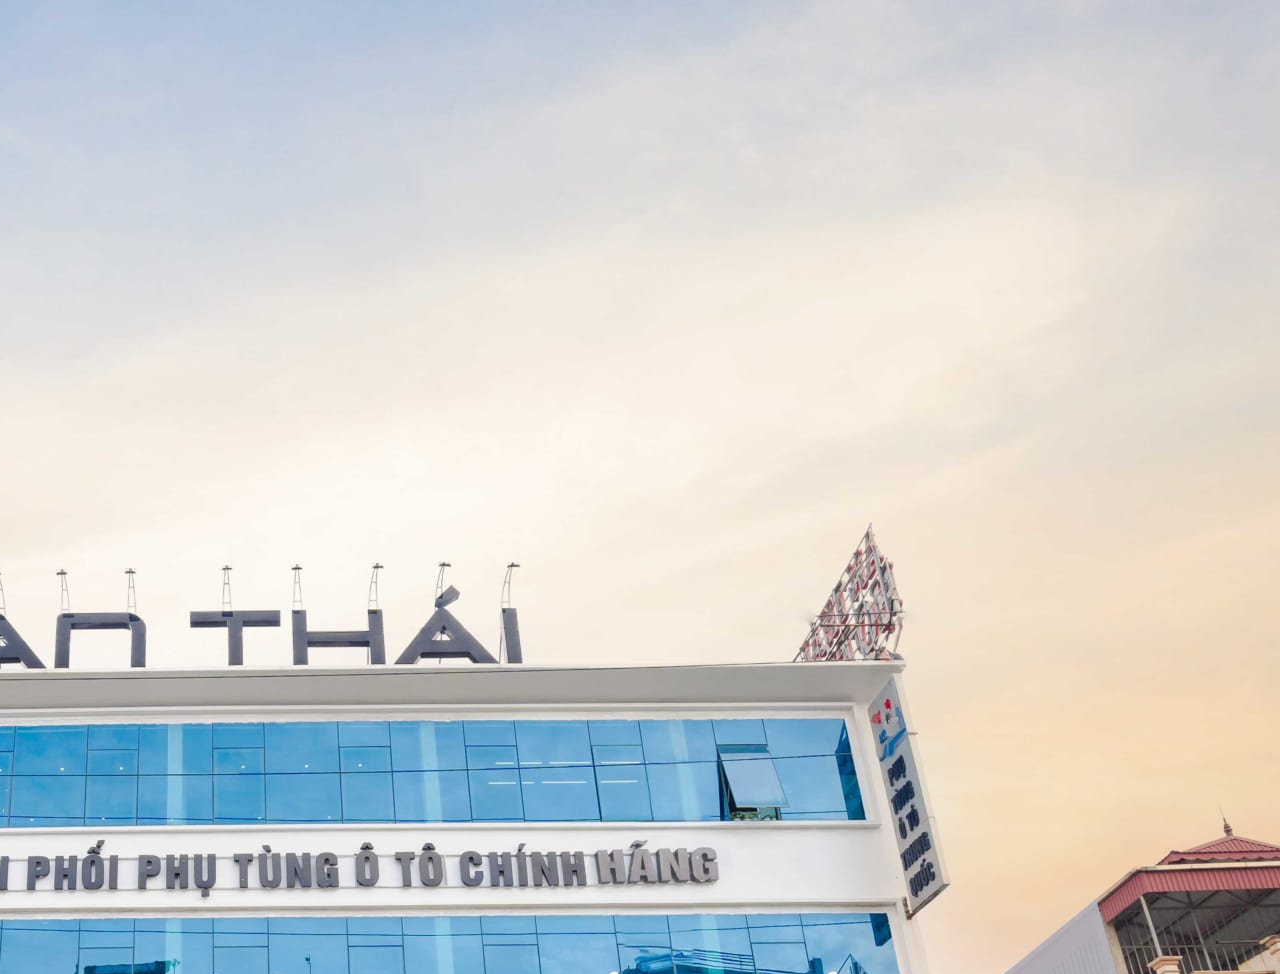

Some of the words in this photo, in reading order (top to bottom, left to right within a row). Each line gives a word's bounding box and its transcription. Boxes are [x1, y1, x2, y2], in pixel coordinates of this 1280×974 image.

[190, 585, 523, 666] THÁI
[27, 839, 119, 891] PHỐI
[138, 853, 216, 897] PHỤ
[233, 845, 339, 889] TÙNG
[356, 842, 380, 887] Ô
[395, 843, 443, 887] TÔ
[459, 843, 587, 888] CHÍNH
[595, 839, 719, 885] HÃNG
